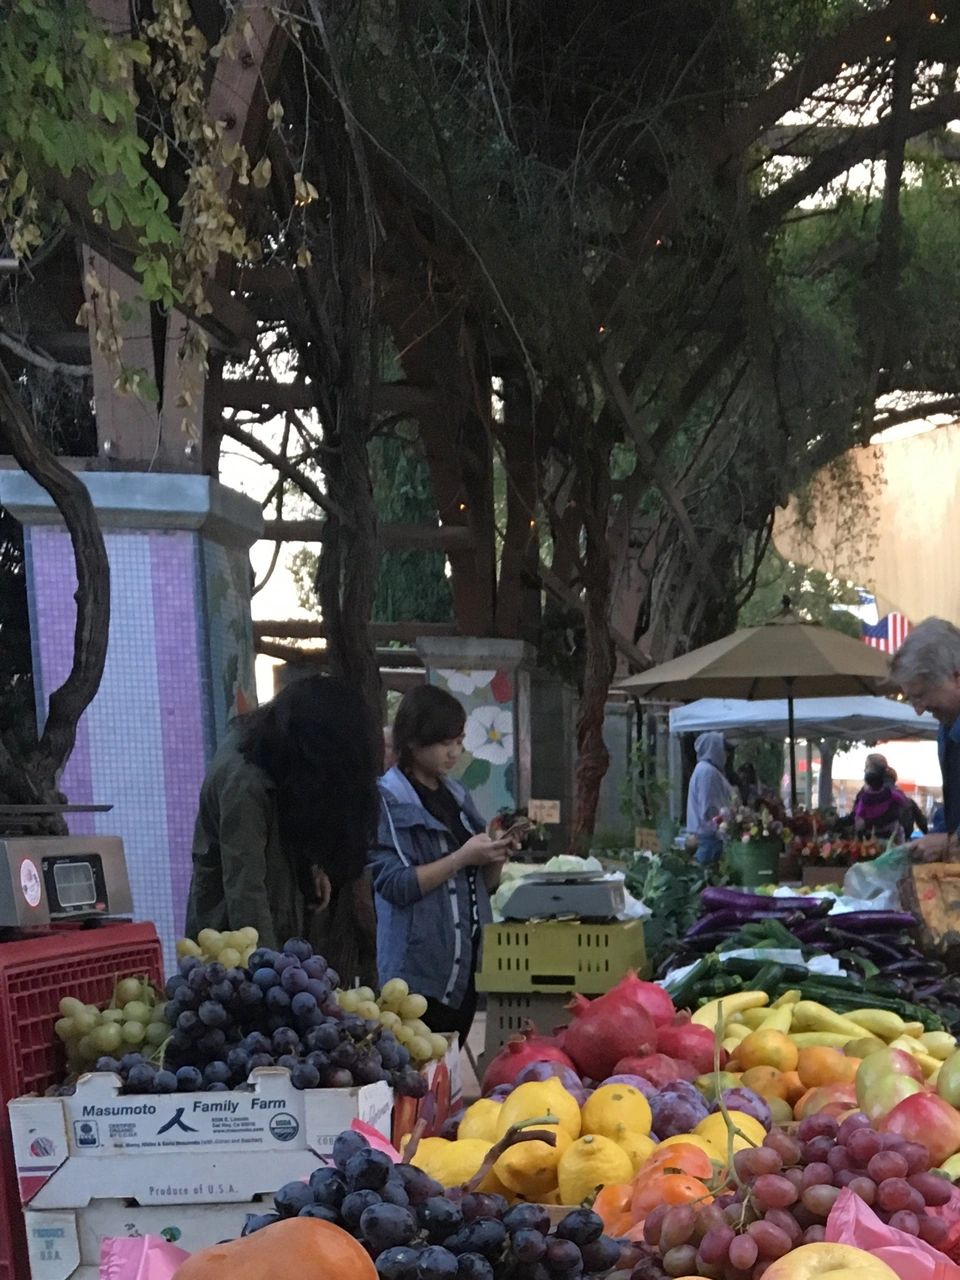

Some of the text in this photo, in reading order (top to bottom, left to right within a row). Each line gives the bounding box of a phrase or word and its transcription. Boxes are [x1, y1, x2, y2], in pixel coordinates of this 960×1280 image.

[82, 1098, 286, 1117] Masumoto Family Farm
[149, 1185, 188, 1196] Produce
[193, 1184, 203, 1194] of
